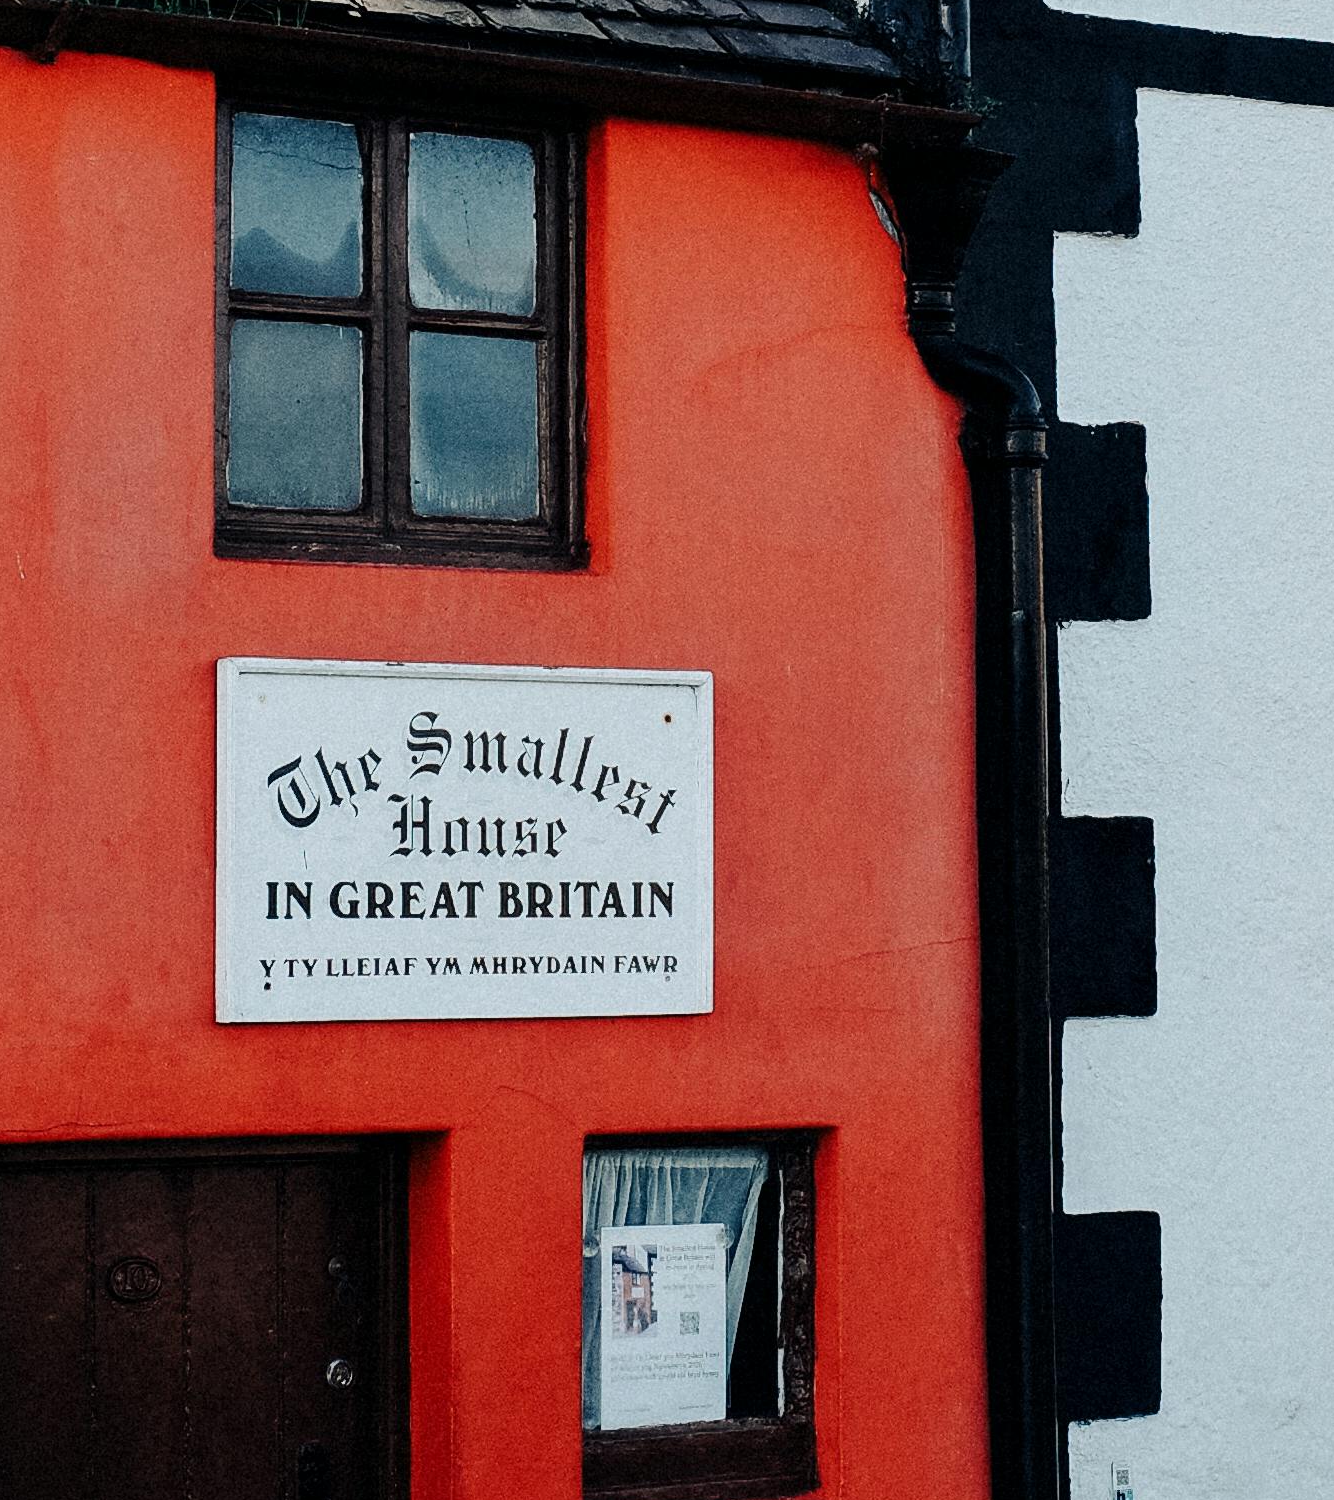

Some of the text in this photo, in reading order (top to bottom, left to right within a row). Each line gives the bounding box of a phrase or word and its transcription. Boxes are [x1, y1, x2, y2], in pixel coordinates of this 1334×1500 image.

[267, 711, 678, 836] The Smallest
[387, 793, 569, 859] House
[265, 880, 675, 921] IN GREAT BRITAIN
[259, 955, 678, 978] Y TY LLEIAF YM MHRYDAIN FAWR
